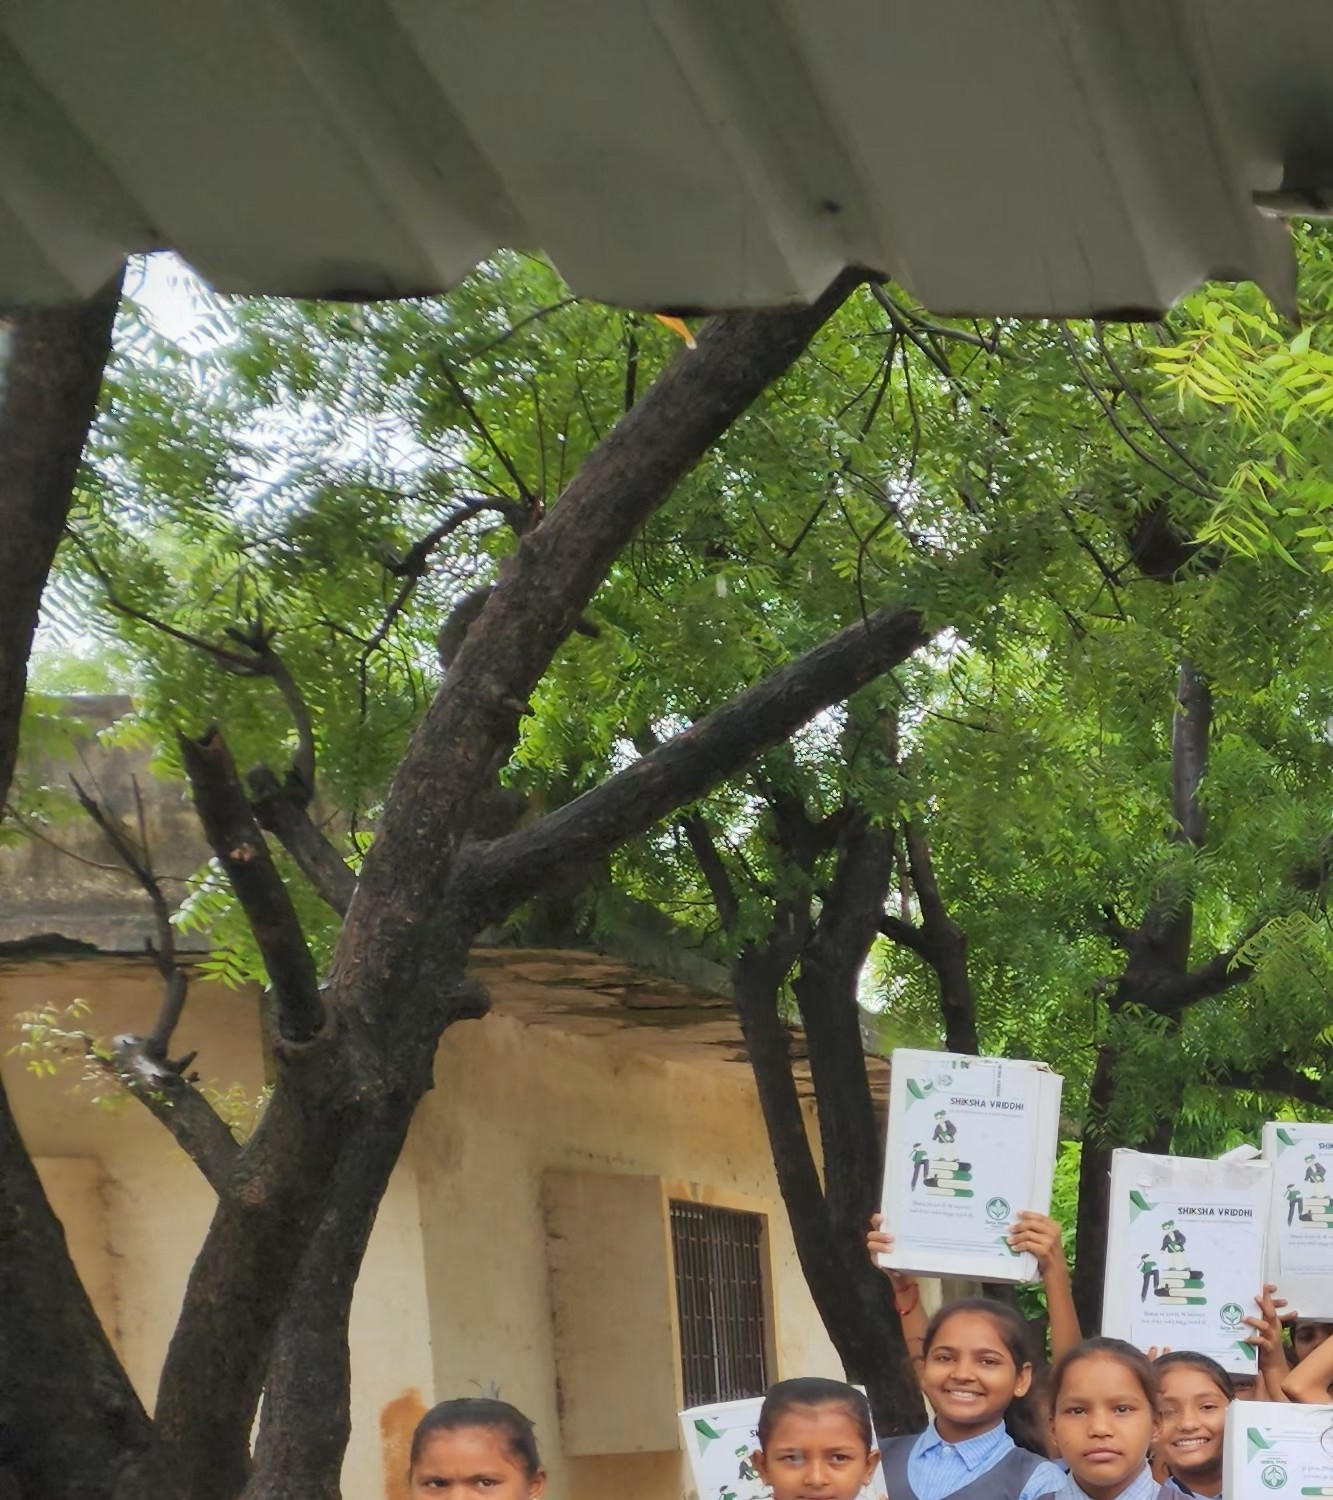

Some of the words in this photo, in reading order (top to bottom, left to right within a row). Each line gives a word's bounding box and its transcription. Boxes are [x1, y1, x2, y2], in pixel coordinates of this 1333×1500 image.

[951, 1098, 986, 1108] SHIKSHA
[990, 1101, 1024, 1111] VRIDDHI
[1178, 1207, 1215, 1216] SHIKSHA
[1218, 1208, 1253, 1217] VRIDDHI
